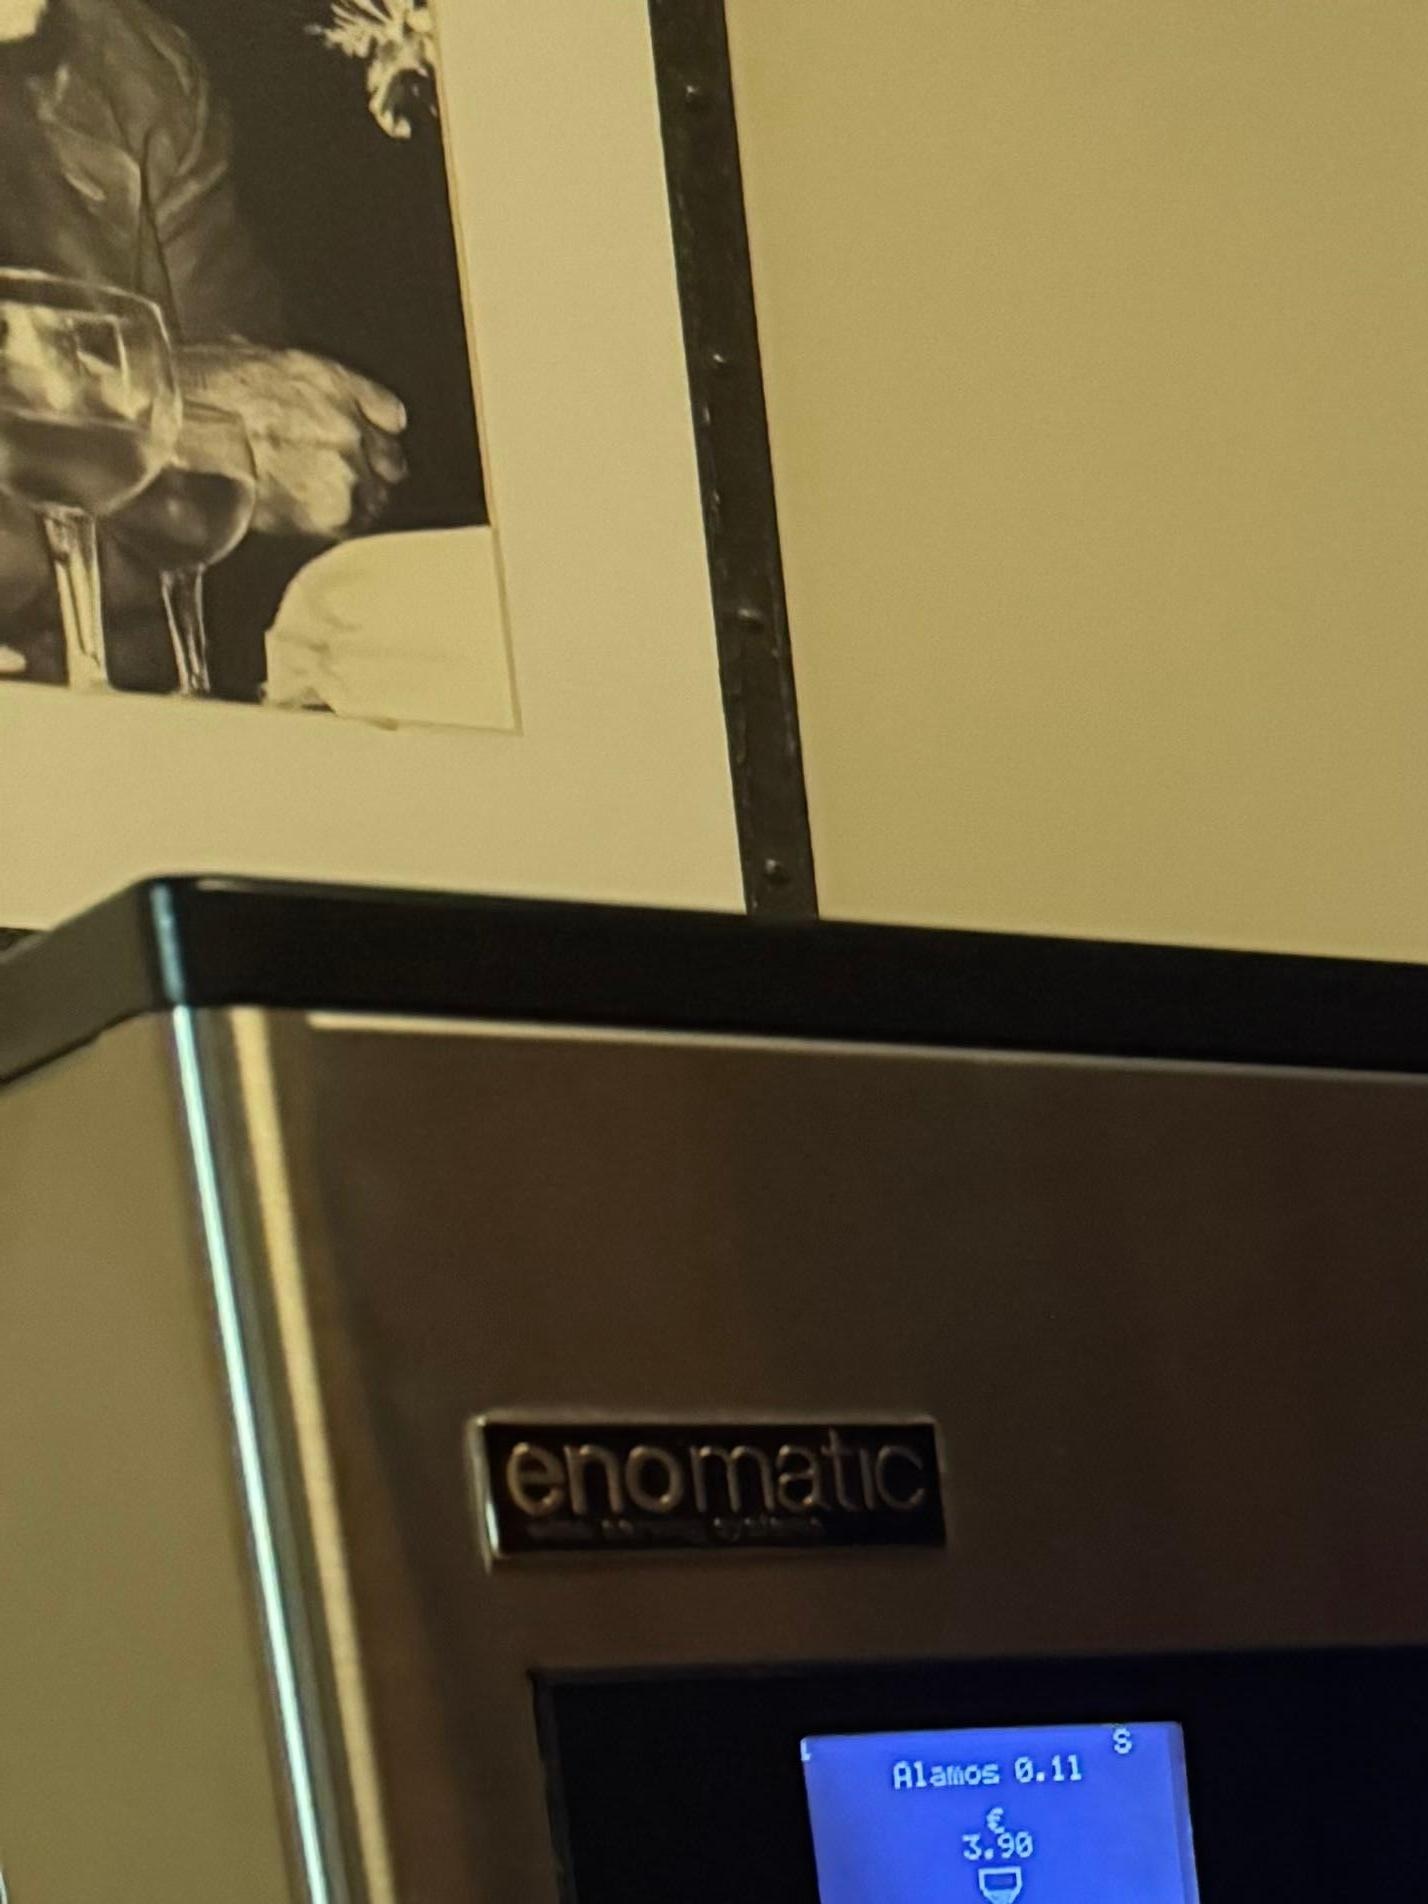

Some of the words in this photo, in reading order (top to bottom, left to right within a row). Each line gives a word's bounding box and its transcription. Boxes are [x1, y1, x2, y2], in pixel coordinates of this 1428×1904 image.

[507, 1427, 926, 1517] enomatic
[1113, 1727, 1133, 1755] S
[893, 1761, 1000, 1790] Alamos
[1015, 1754, 1082, 1784] 0.11
[962, 1831, 1034, 1861] 3.90
